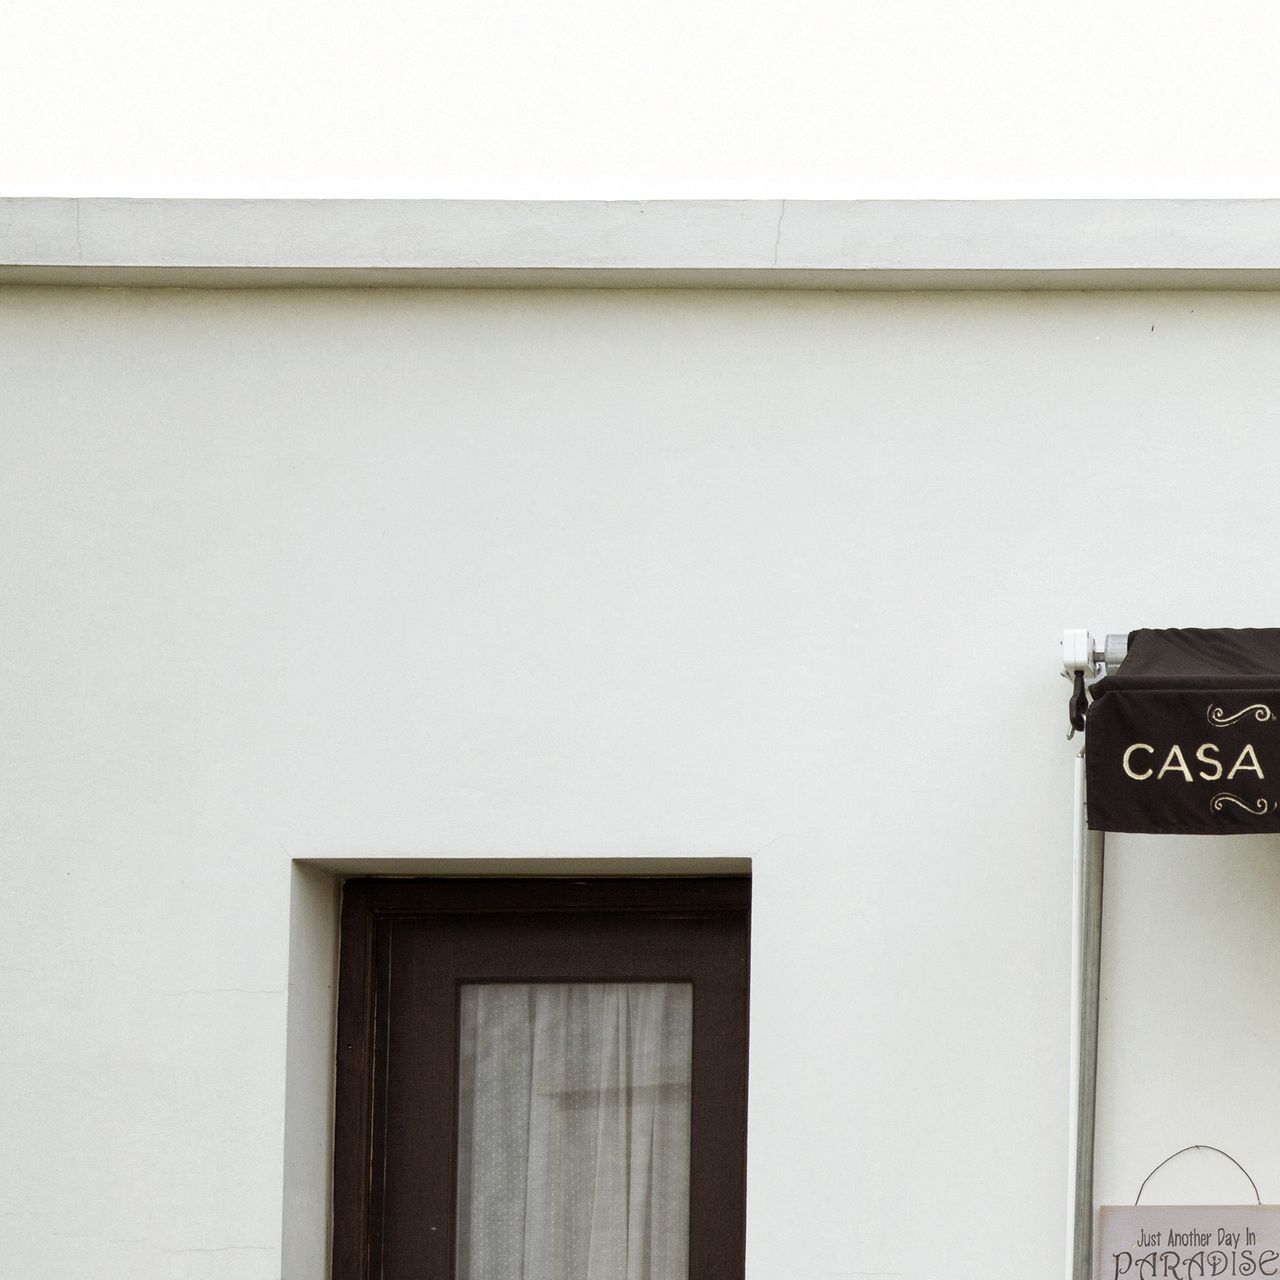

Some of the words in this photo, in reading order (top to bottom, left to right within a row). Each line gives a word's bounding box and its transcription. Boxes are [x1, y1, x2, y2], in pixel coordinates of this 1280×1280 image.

[1122, 743, 1265, 783] CASA
[1136, 1228, 1162, 1248] Just
[1167, 1228, 1212, 1248] Another
[1217, 1227, 1241, 1249] Day
[1245, 1226, 1256, 1246] In
